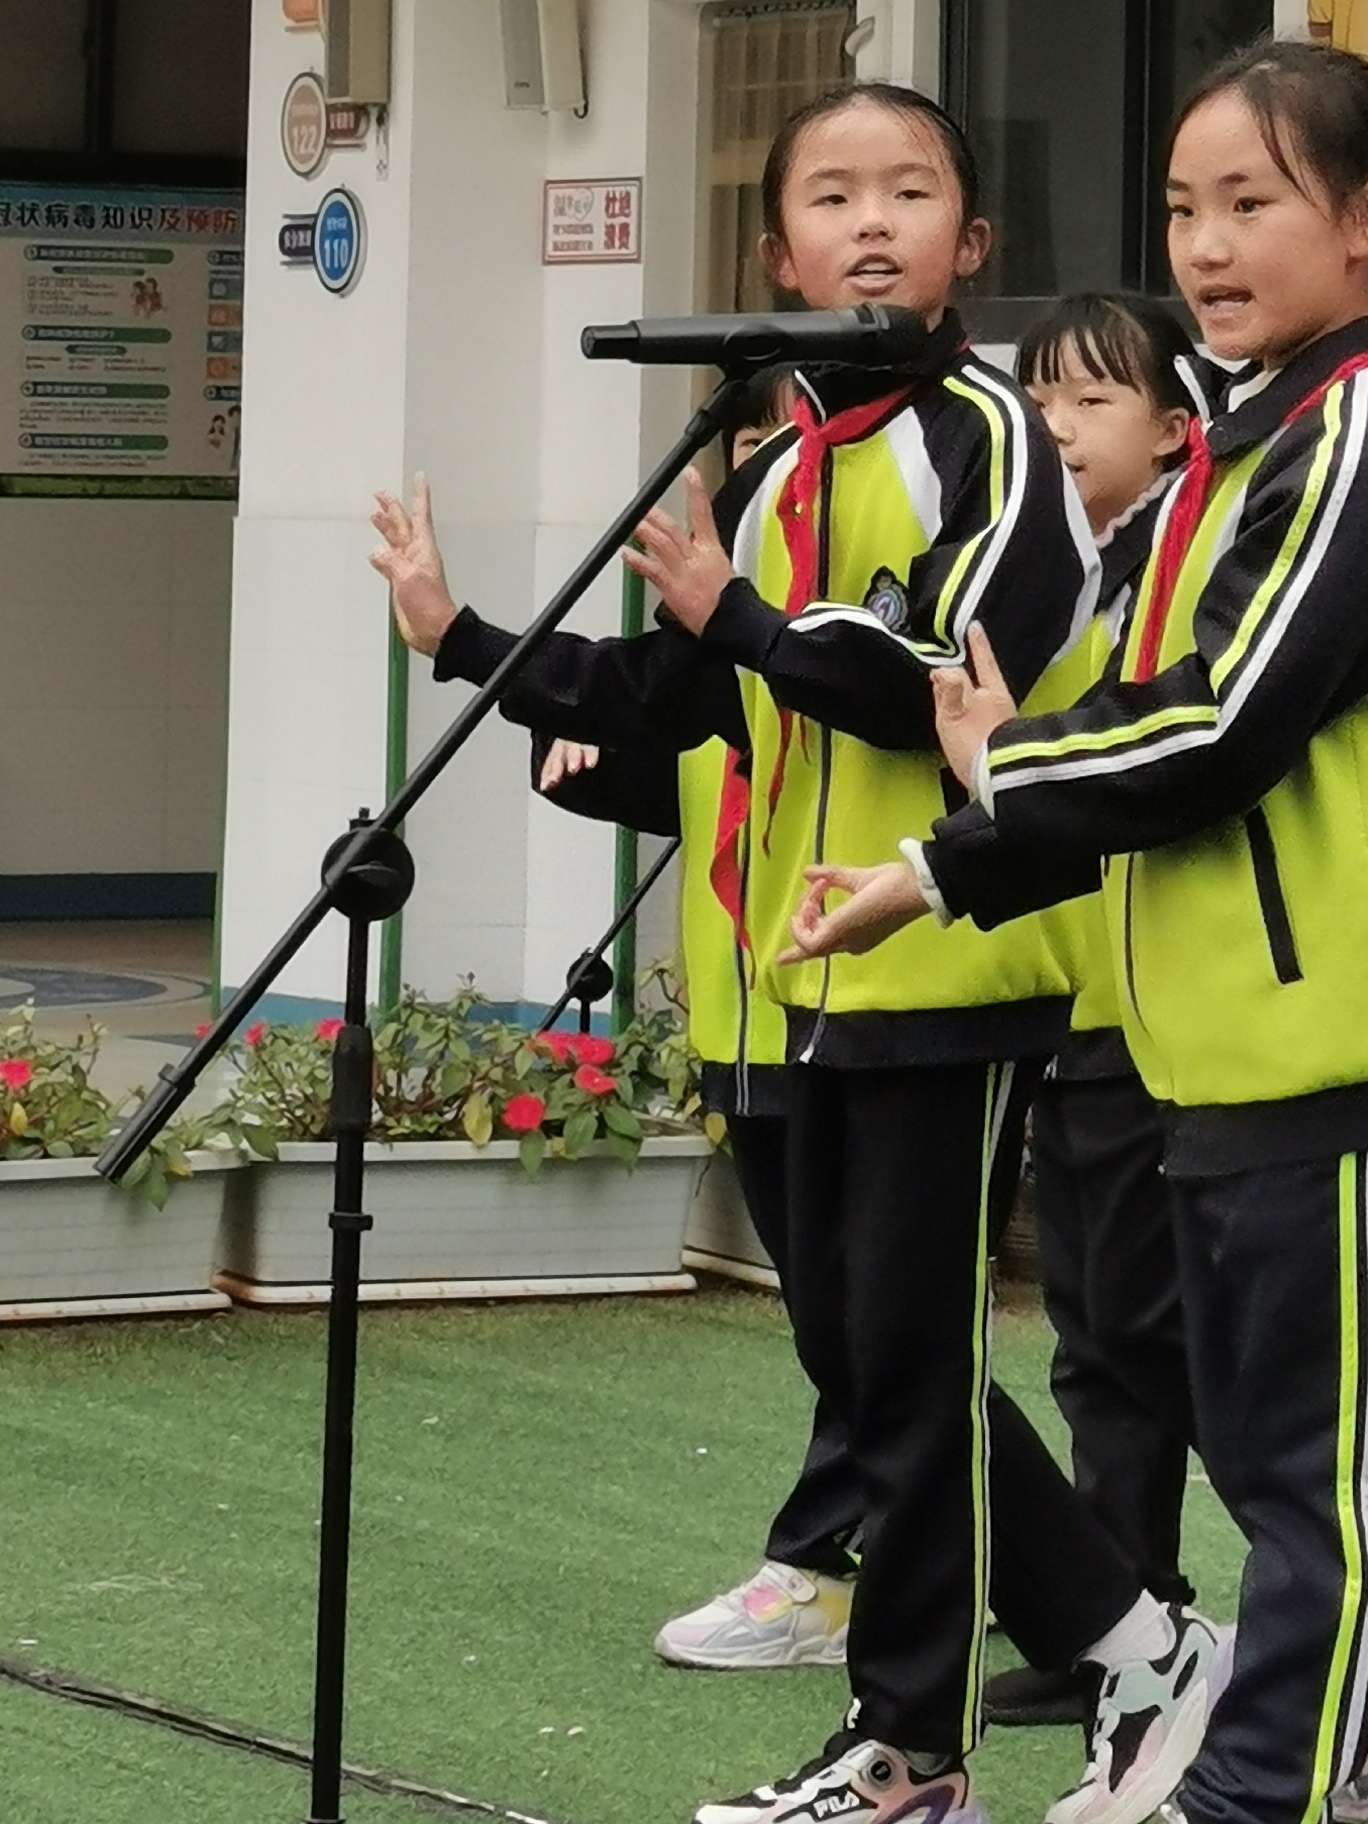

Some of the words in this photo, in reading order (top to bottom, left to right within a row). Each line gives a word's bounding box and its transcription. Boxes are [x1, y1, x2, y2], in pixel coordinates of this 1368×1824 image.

[293, 124, 317, 155] 122
[324, 237, 349, 269] 110
[813, 1790, 860, 1819] FILA
